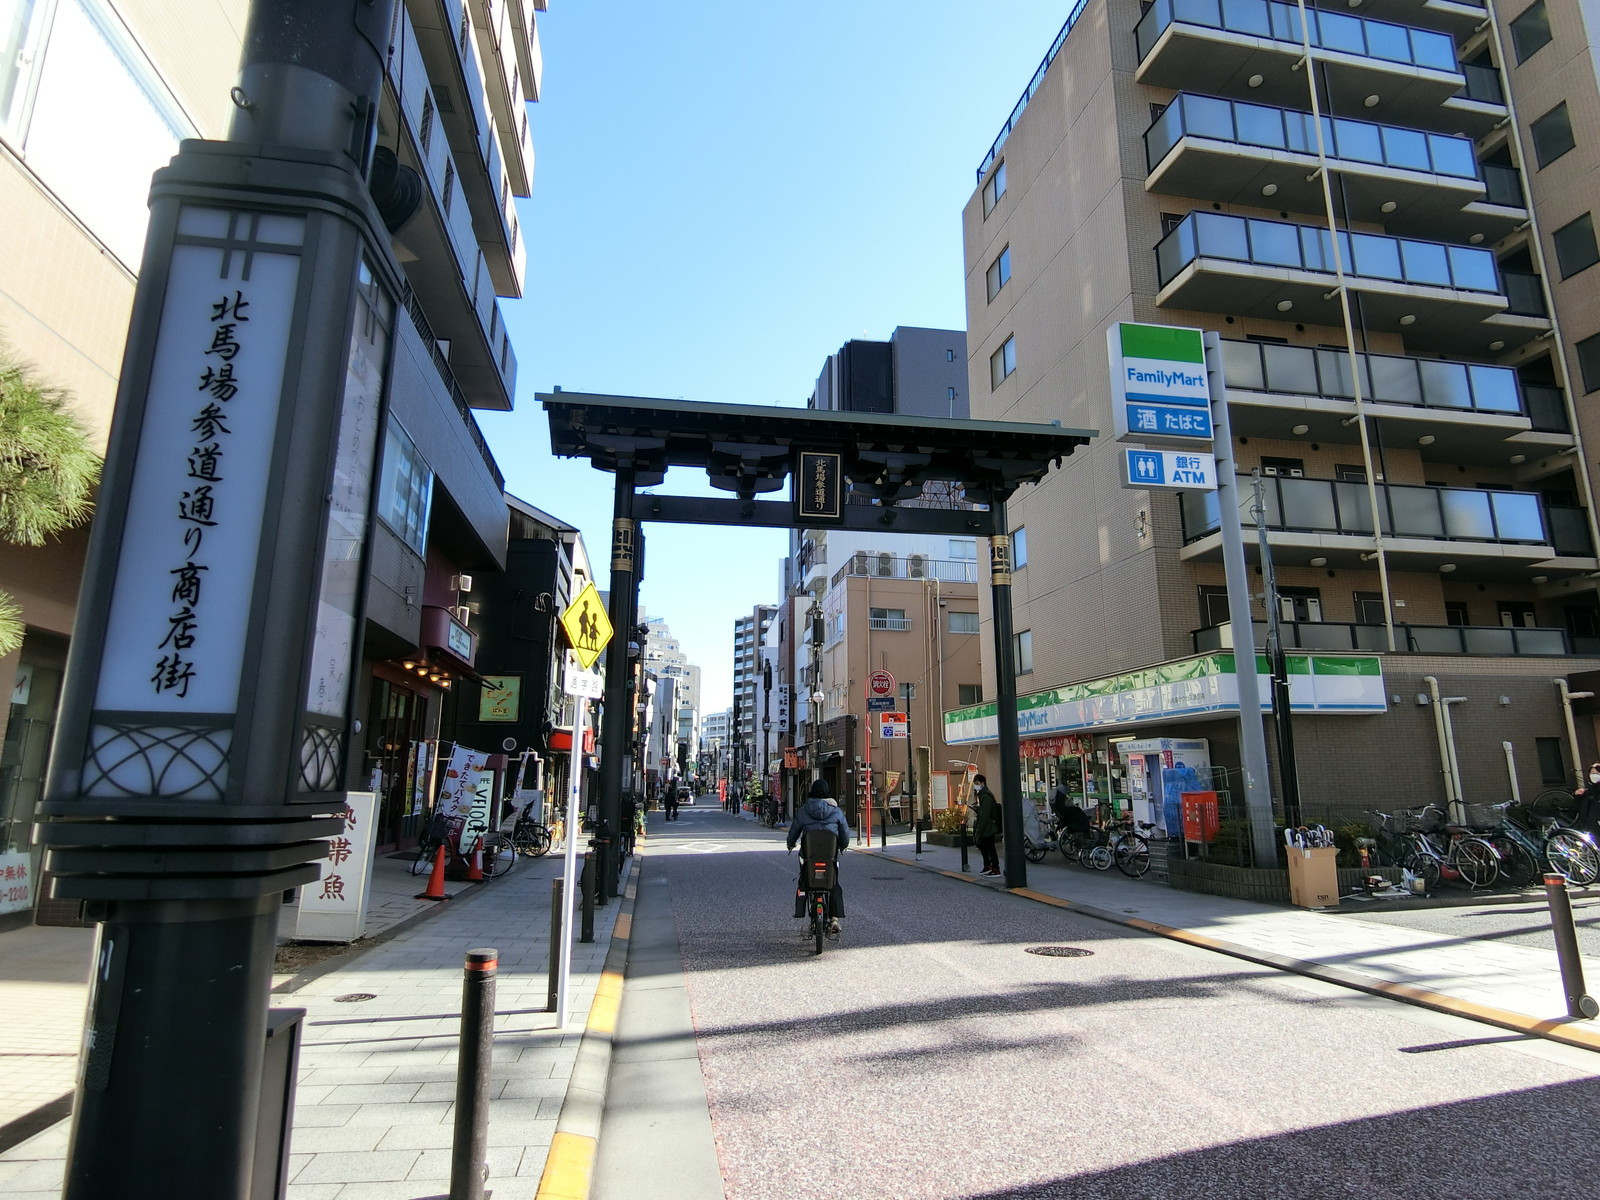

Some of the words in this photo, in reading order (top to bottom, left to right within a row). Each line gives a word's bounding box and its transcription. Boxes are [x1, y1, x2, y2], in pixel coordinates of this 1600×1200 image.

[1127, 367, 1205, 388] FamilyMart
[1137, 408, 1158, 431] 酒
[1165, 413, 1206, 431] たばこ
[1176, 456, 1201, 470] 銀行
[815, 459, 827, 510] 北馬場参道通り
[1173, 471, 1206, 485] ATM
[150, 289, 250, 699] 北馬場参道通り商店街
[1017, 710, 1048, 731] milyMart
[451, 754, 476, 812] できたてパスタ
